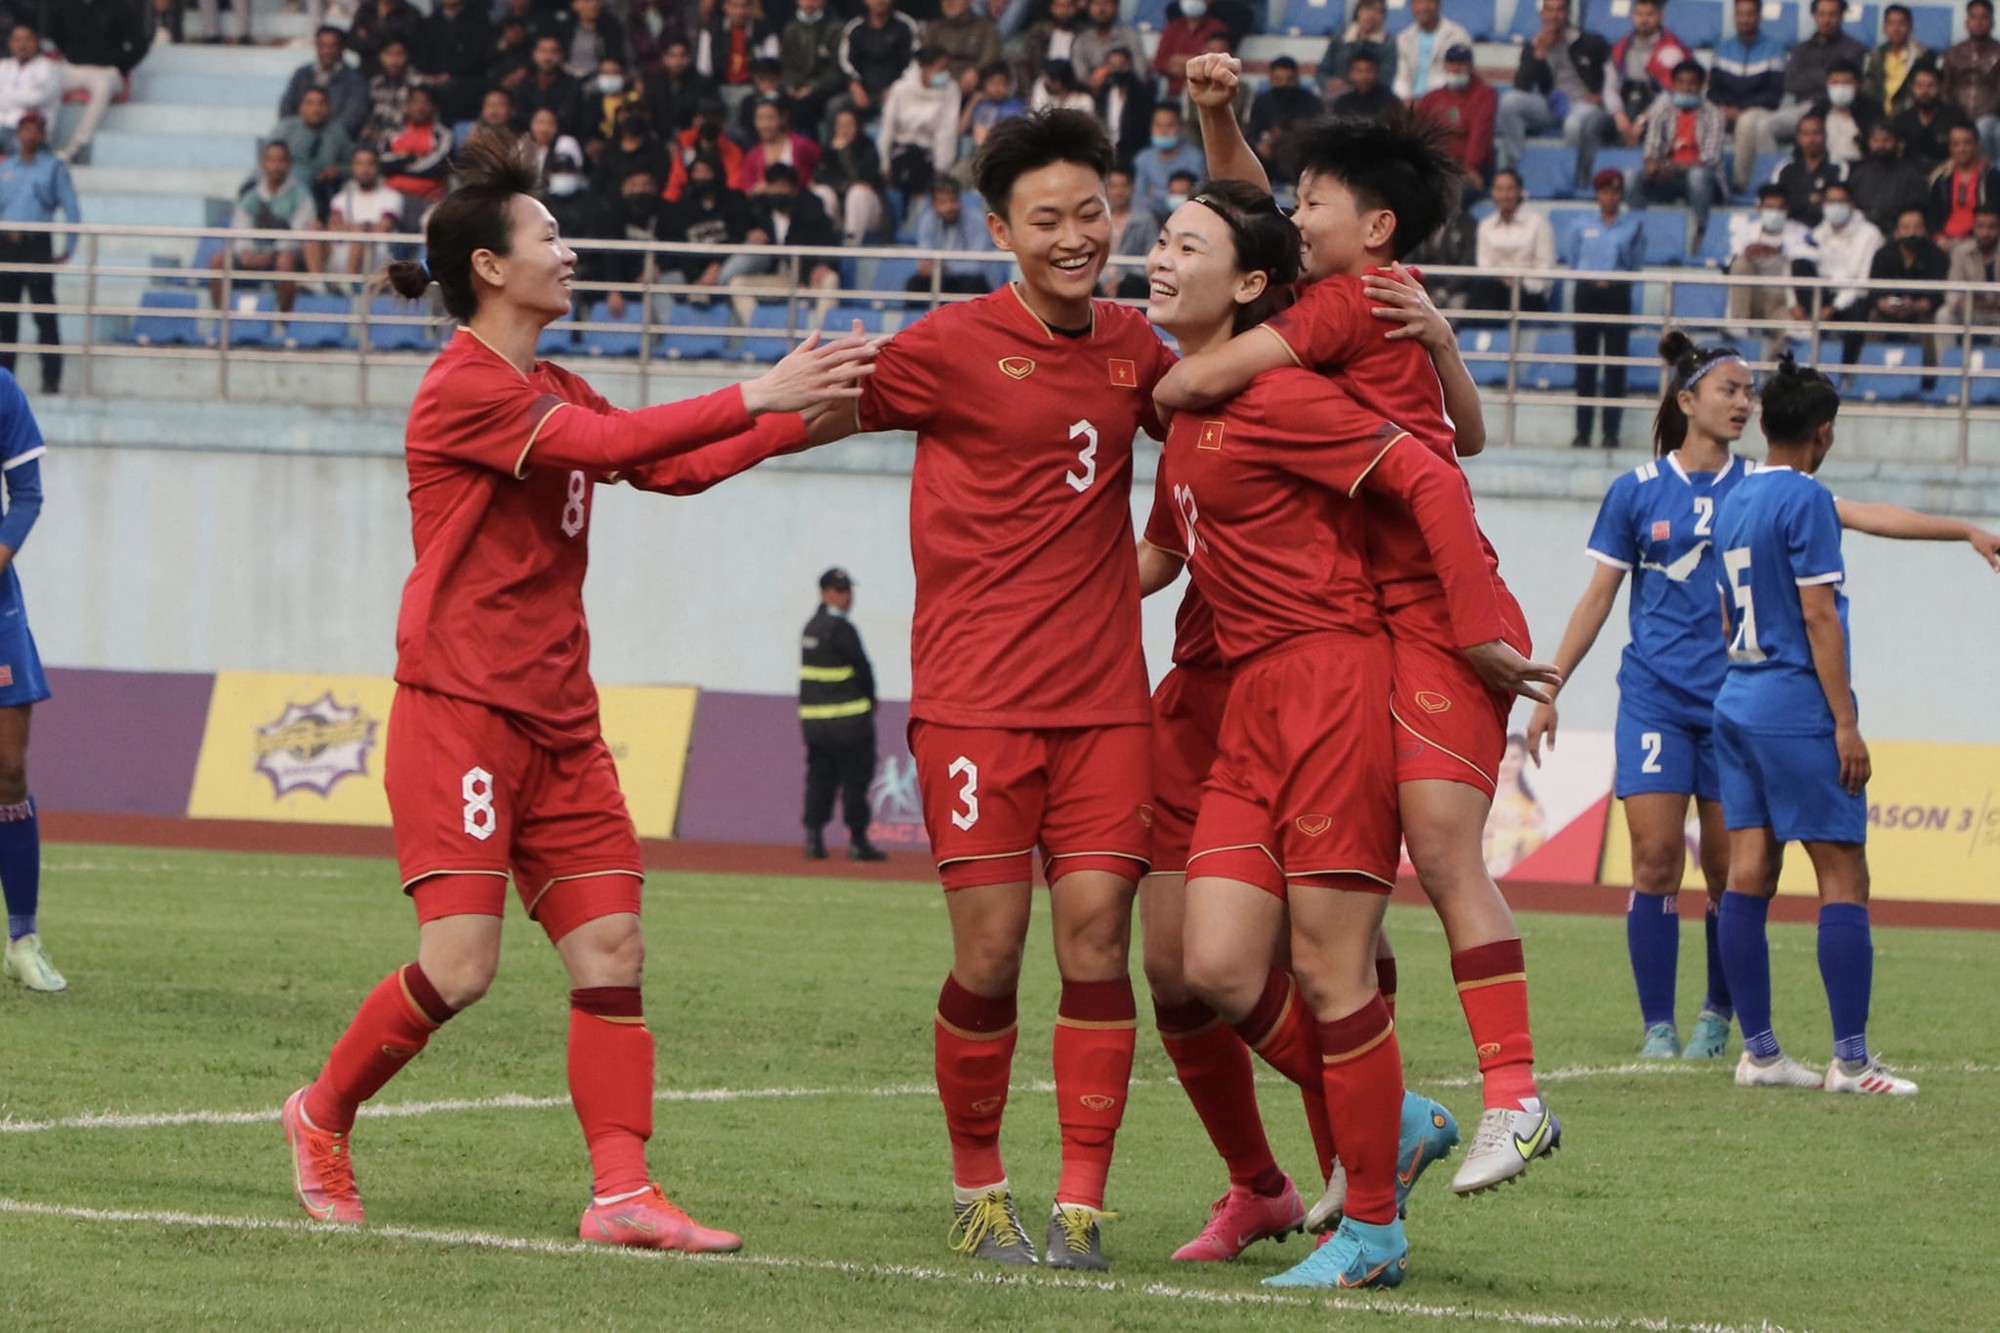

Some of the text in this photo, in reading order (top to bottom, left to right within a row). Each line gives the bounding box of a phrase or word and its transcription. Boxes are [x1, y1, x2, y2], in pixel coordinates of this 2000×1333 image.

[1066, 419, 1098, 493] 3
[561, 469, 585, 537] 8
[1694, 497, 1713, 536] 2
[1642, 732, 1661, 773] 2
[462, 766, 496, 840] 8
[948, 755, 979, 831] 3
[1866, 803, 1951, 831] ASON
[1955, 807, 1974, 833] 3
